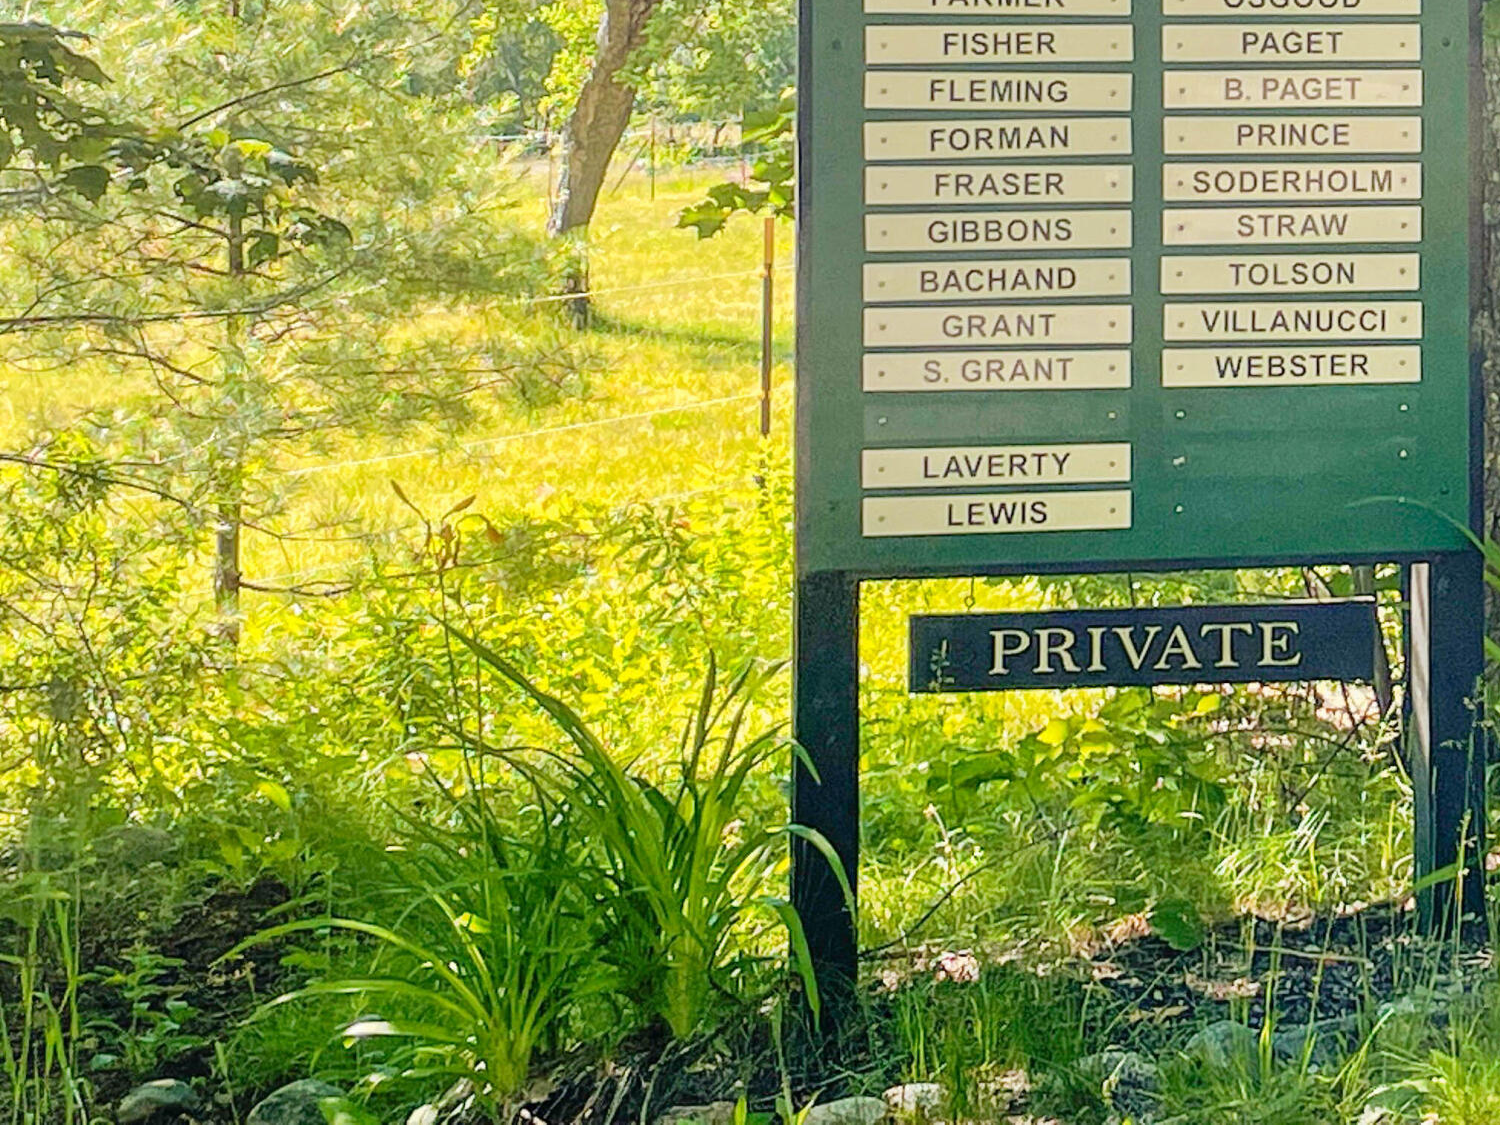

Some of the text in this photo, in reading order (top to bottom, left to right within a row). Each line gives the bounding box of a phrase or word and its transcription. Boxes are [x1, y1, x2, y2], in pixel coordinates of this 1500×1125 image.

[943, 32, 1056, 55] FISHER
[1242, 31, 1343, 55] PAGET
[929, 79, 1069, 103] FLEMING
[1224, 77, 1362, 101] B. PAGET
[930, 126, 1070, 151] FORMAN
[1236, 123, 1350, 147] PRINCE
[935, 173, 1064, 197] FRASER
[1193, 170, 1393, 194] SODERHOLM
[927, 219, 1072, 243] GIBBONS
[1237, 215, 1348, 238] STRAW
[920, 267, 1076, 292] BACHAND
[1229, 263, 1355, 286] TOLSON
[942, 313, 1056, 338] GRANT
[1202, 309, 1386, 333] VILLANUCCI
[923, 358, 1074, 384] S. GRANT
[1215, 354, 1370, 378] WEBSTER
[923, 453, 1071, 479] LAVERTY
[948, 502, 1048, 526] LEWIS
[989, 621, 1301, 675] PRIVATE
